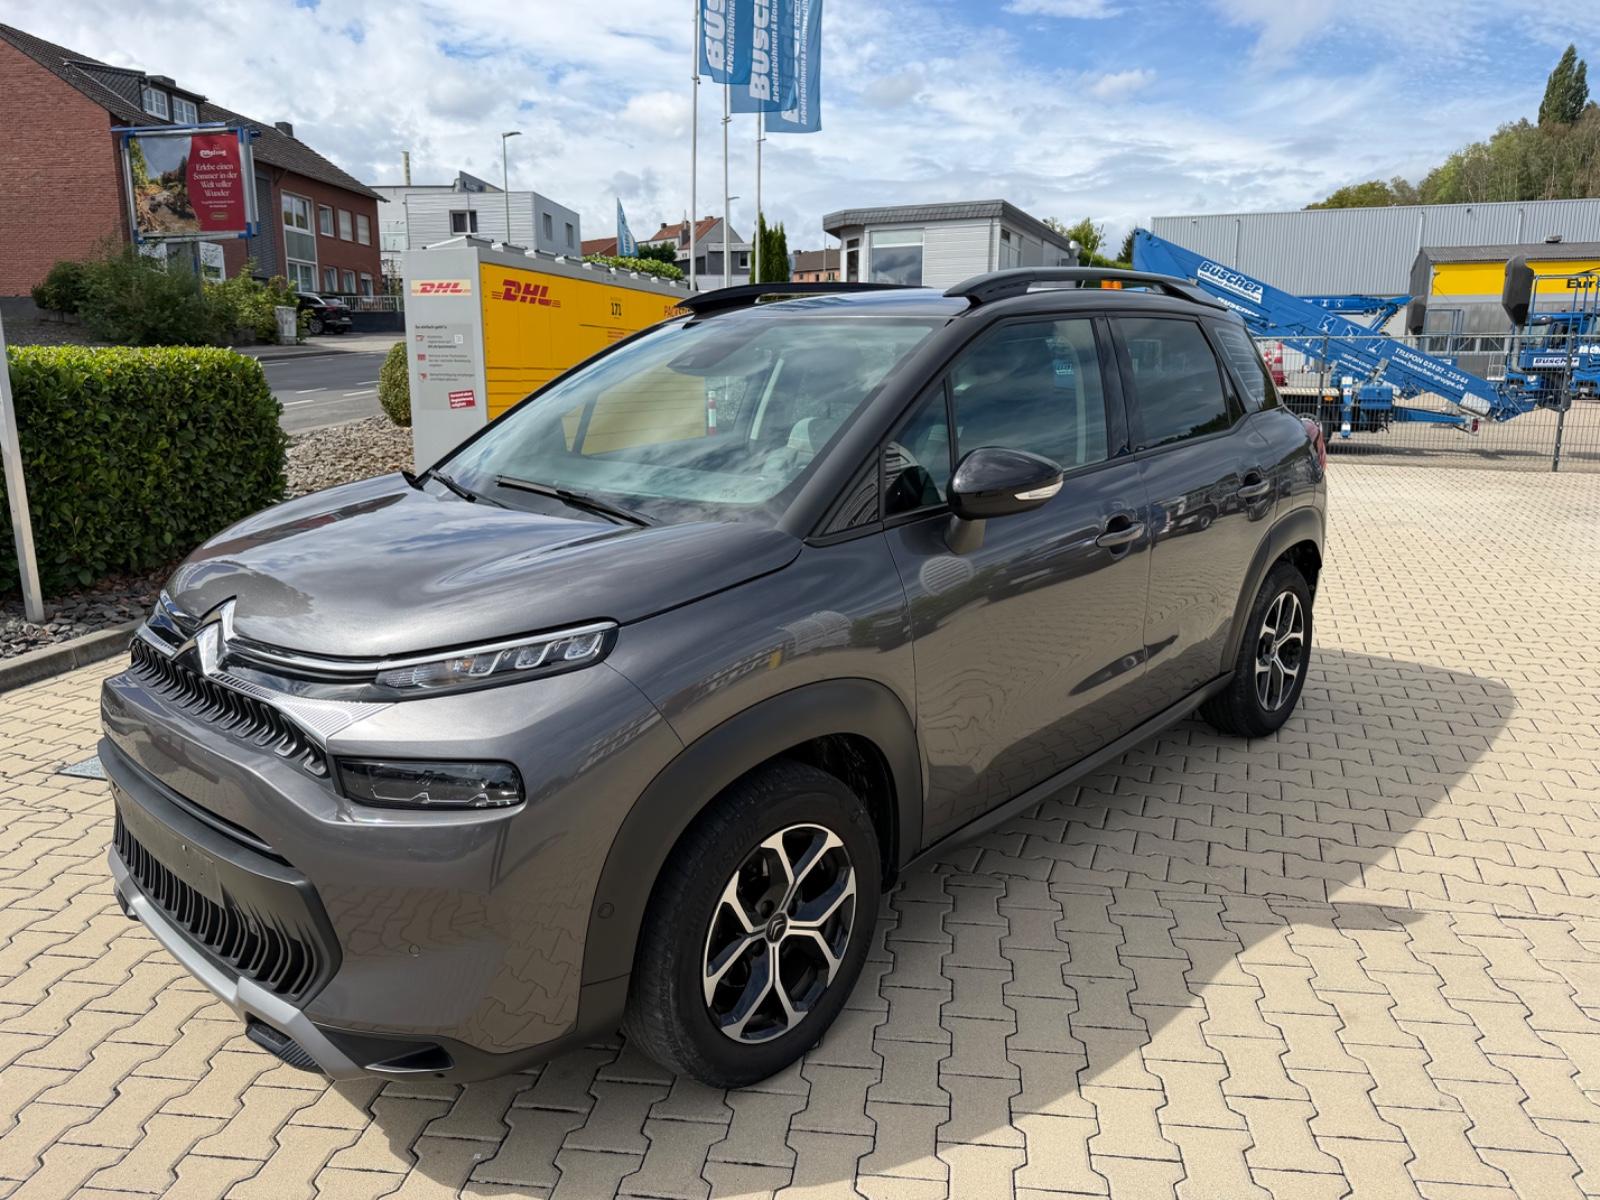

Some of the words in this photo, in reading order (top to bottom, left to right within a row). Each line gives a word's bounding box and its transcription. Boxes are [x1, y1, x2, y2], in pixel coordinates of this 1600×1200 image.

[195, 163, 215, 171] Erlebe
[216, 163, 234, 171] einen
[193, 172, 218, 180] Sommer
[227, 171, 238, 179] der
[200, 180, 215, 189] Welt
[204, 189, 230, 197] Wunder
[419, 282, 463, 293] DHL
[502, 279, 552, 306] DHL
[611, 302, 622, 316] 171
[1395, 348, 1424, 364] TELEFON
